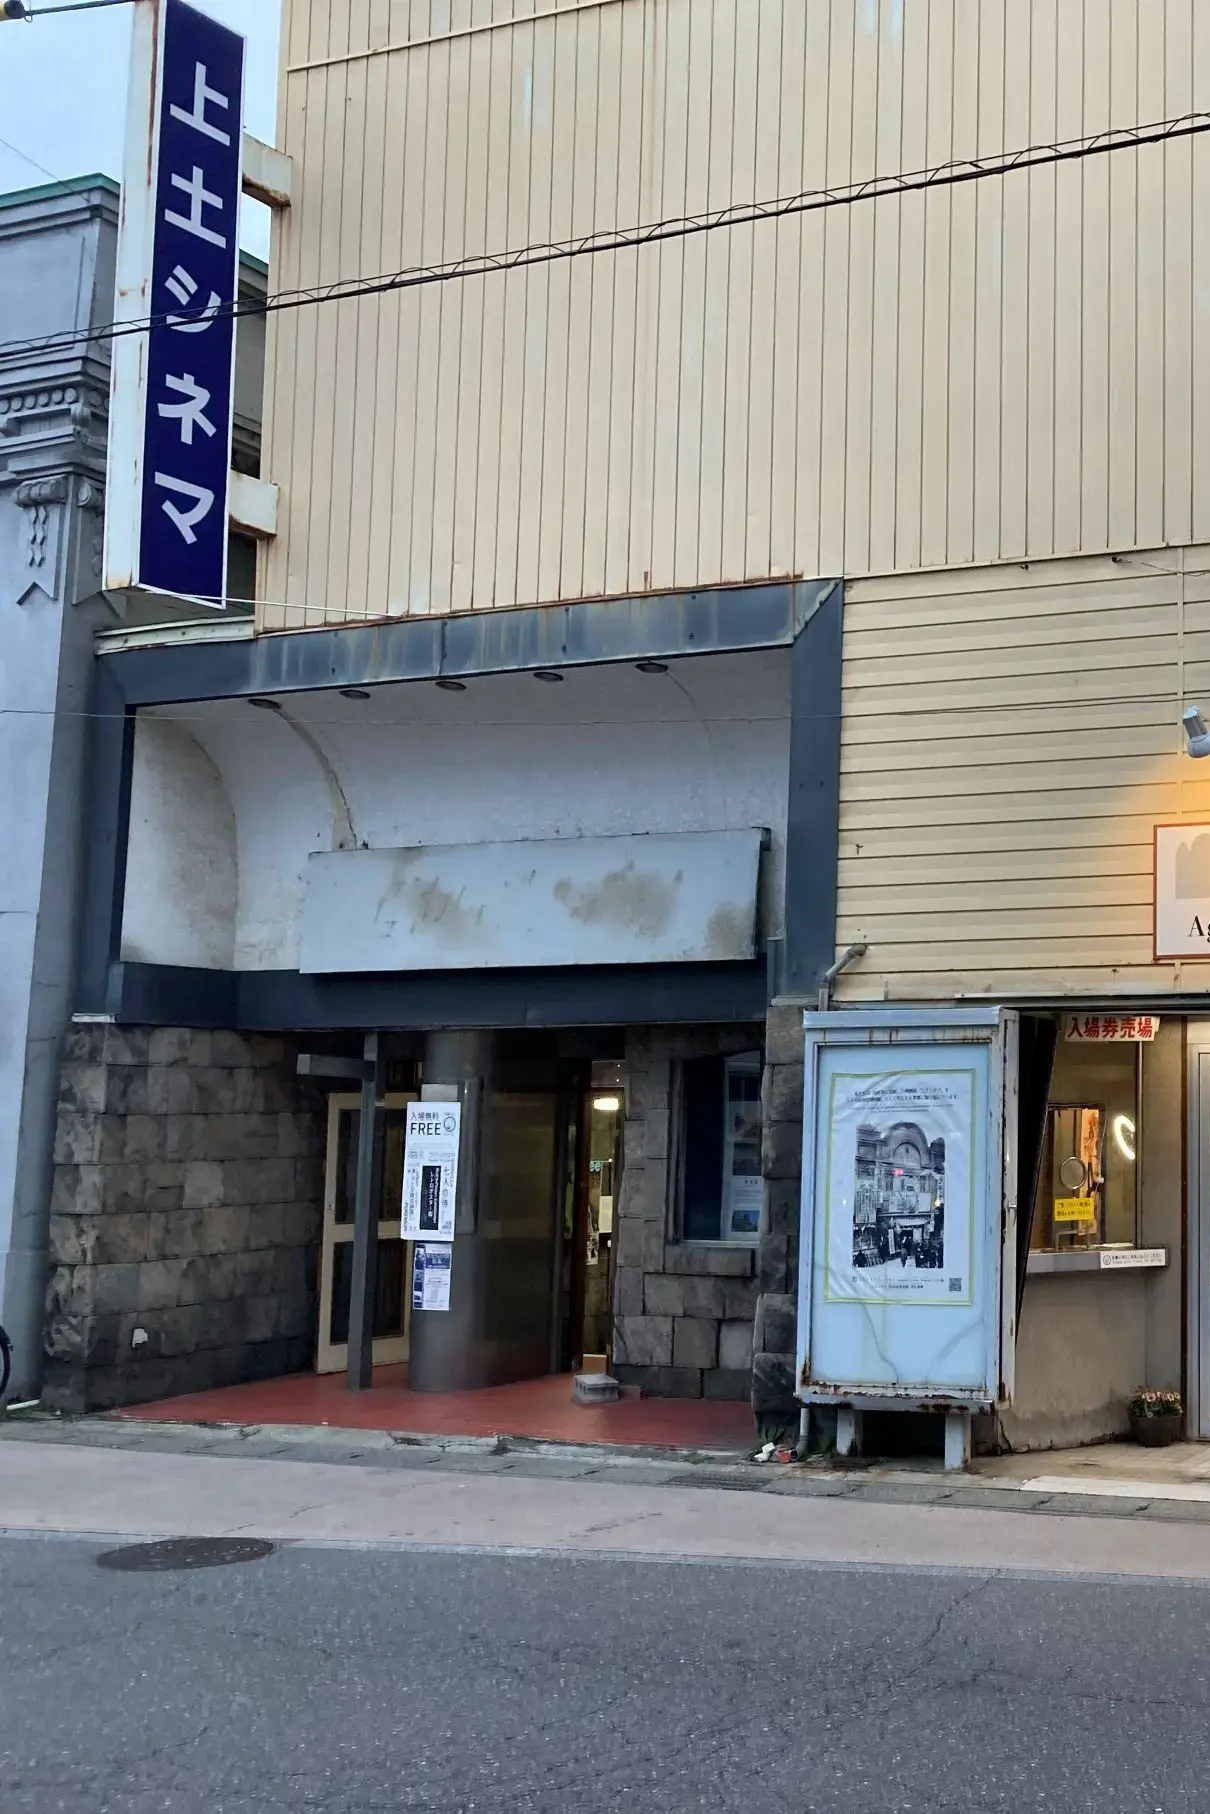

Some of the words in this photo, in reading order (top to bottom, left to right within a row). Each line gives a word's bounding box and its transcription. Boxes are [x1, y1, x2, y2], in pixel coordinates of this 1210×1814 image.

[154, 62, 231, 545] 上土シネマ
[1067, 1016, 1153, 1038] 入場券売場
[410, 1122, 442, 1136] FREE
